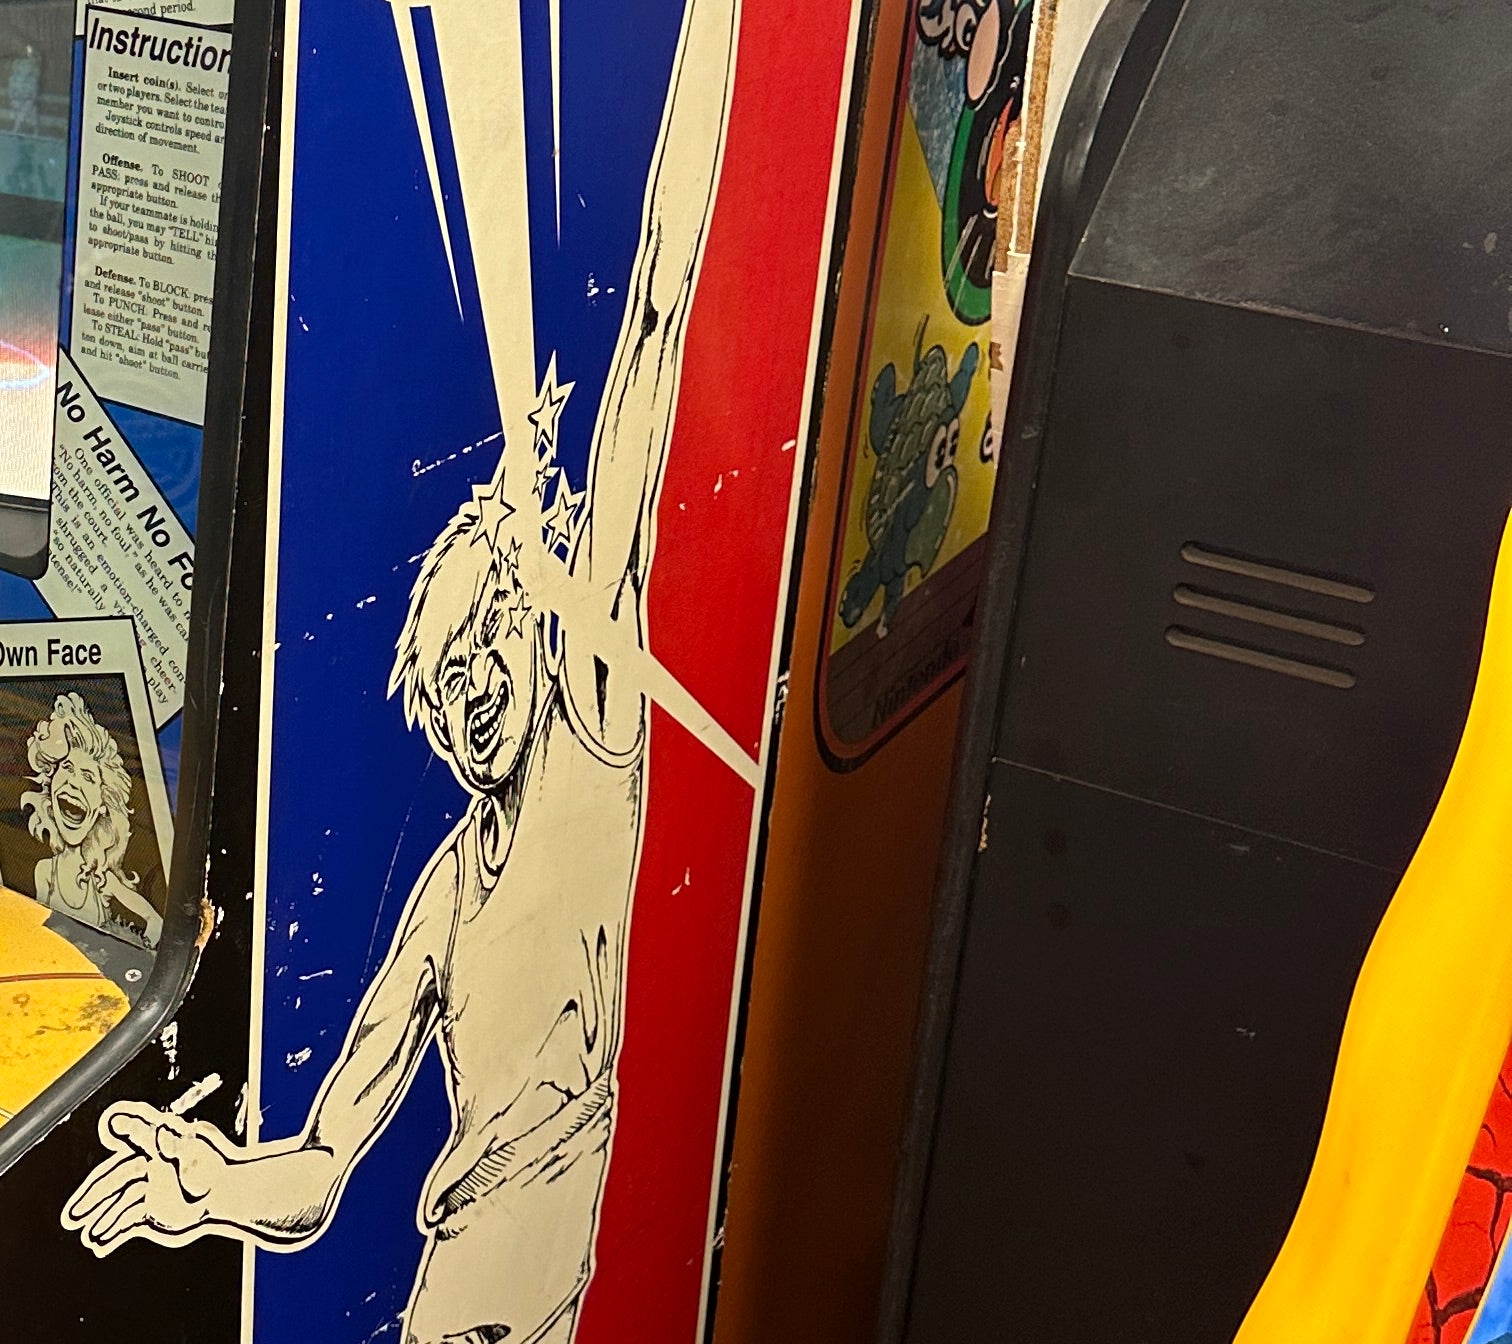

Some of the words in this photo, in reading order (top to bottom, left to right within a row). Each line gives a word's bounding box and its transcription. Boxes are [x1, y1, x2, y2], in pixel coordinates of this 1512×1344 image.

[56, 380, 87, 425] No
[82, 425, 141, 504] Harm
[136, 504, 172, 549] No
[46, 638, 102, 666] Face
